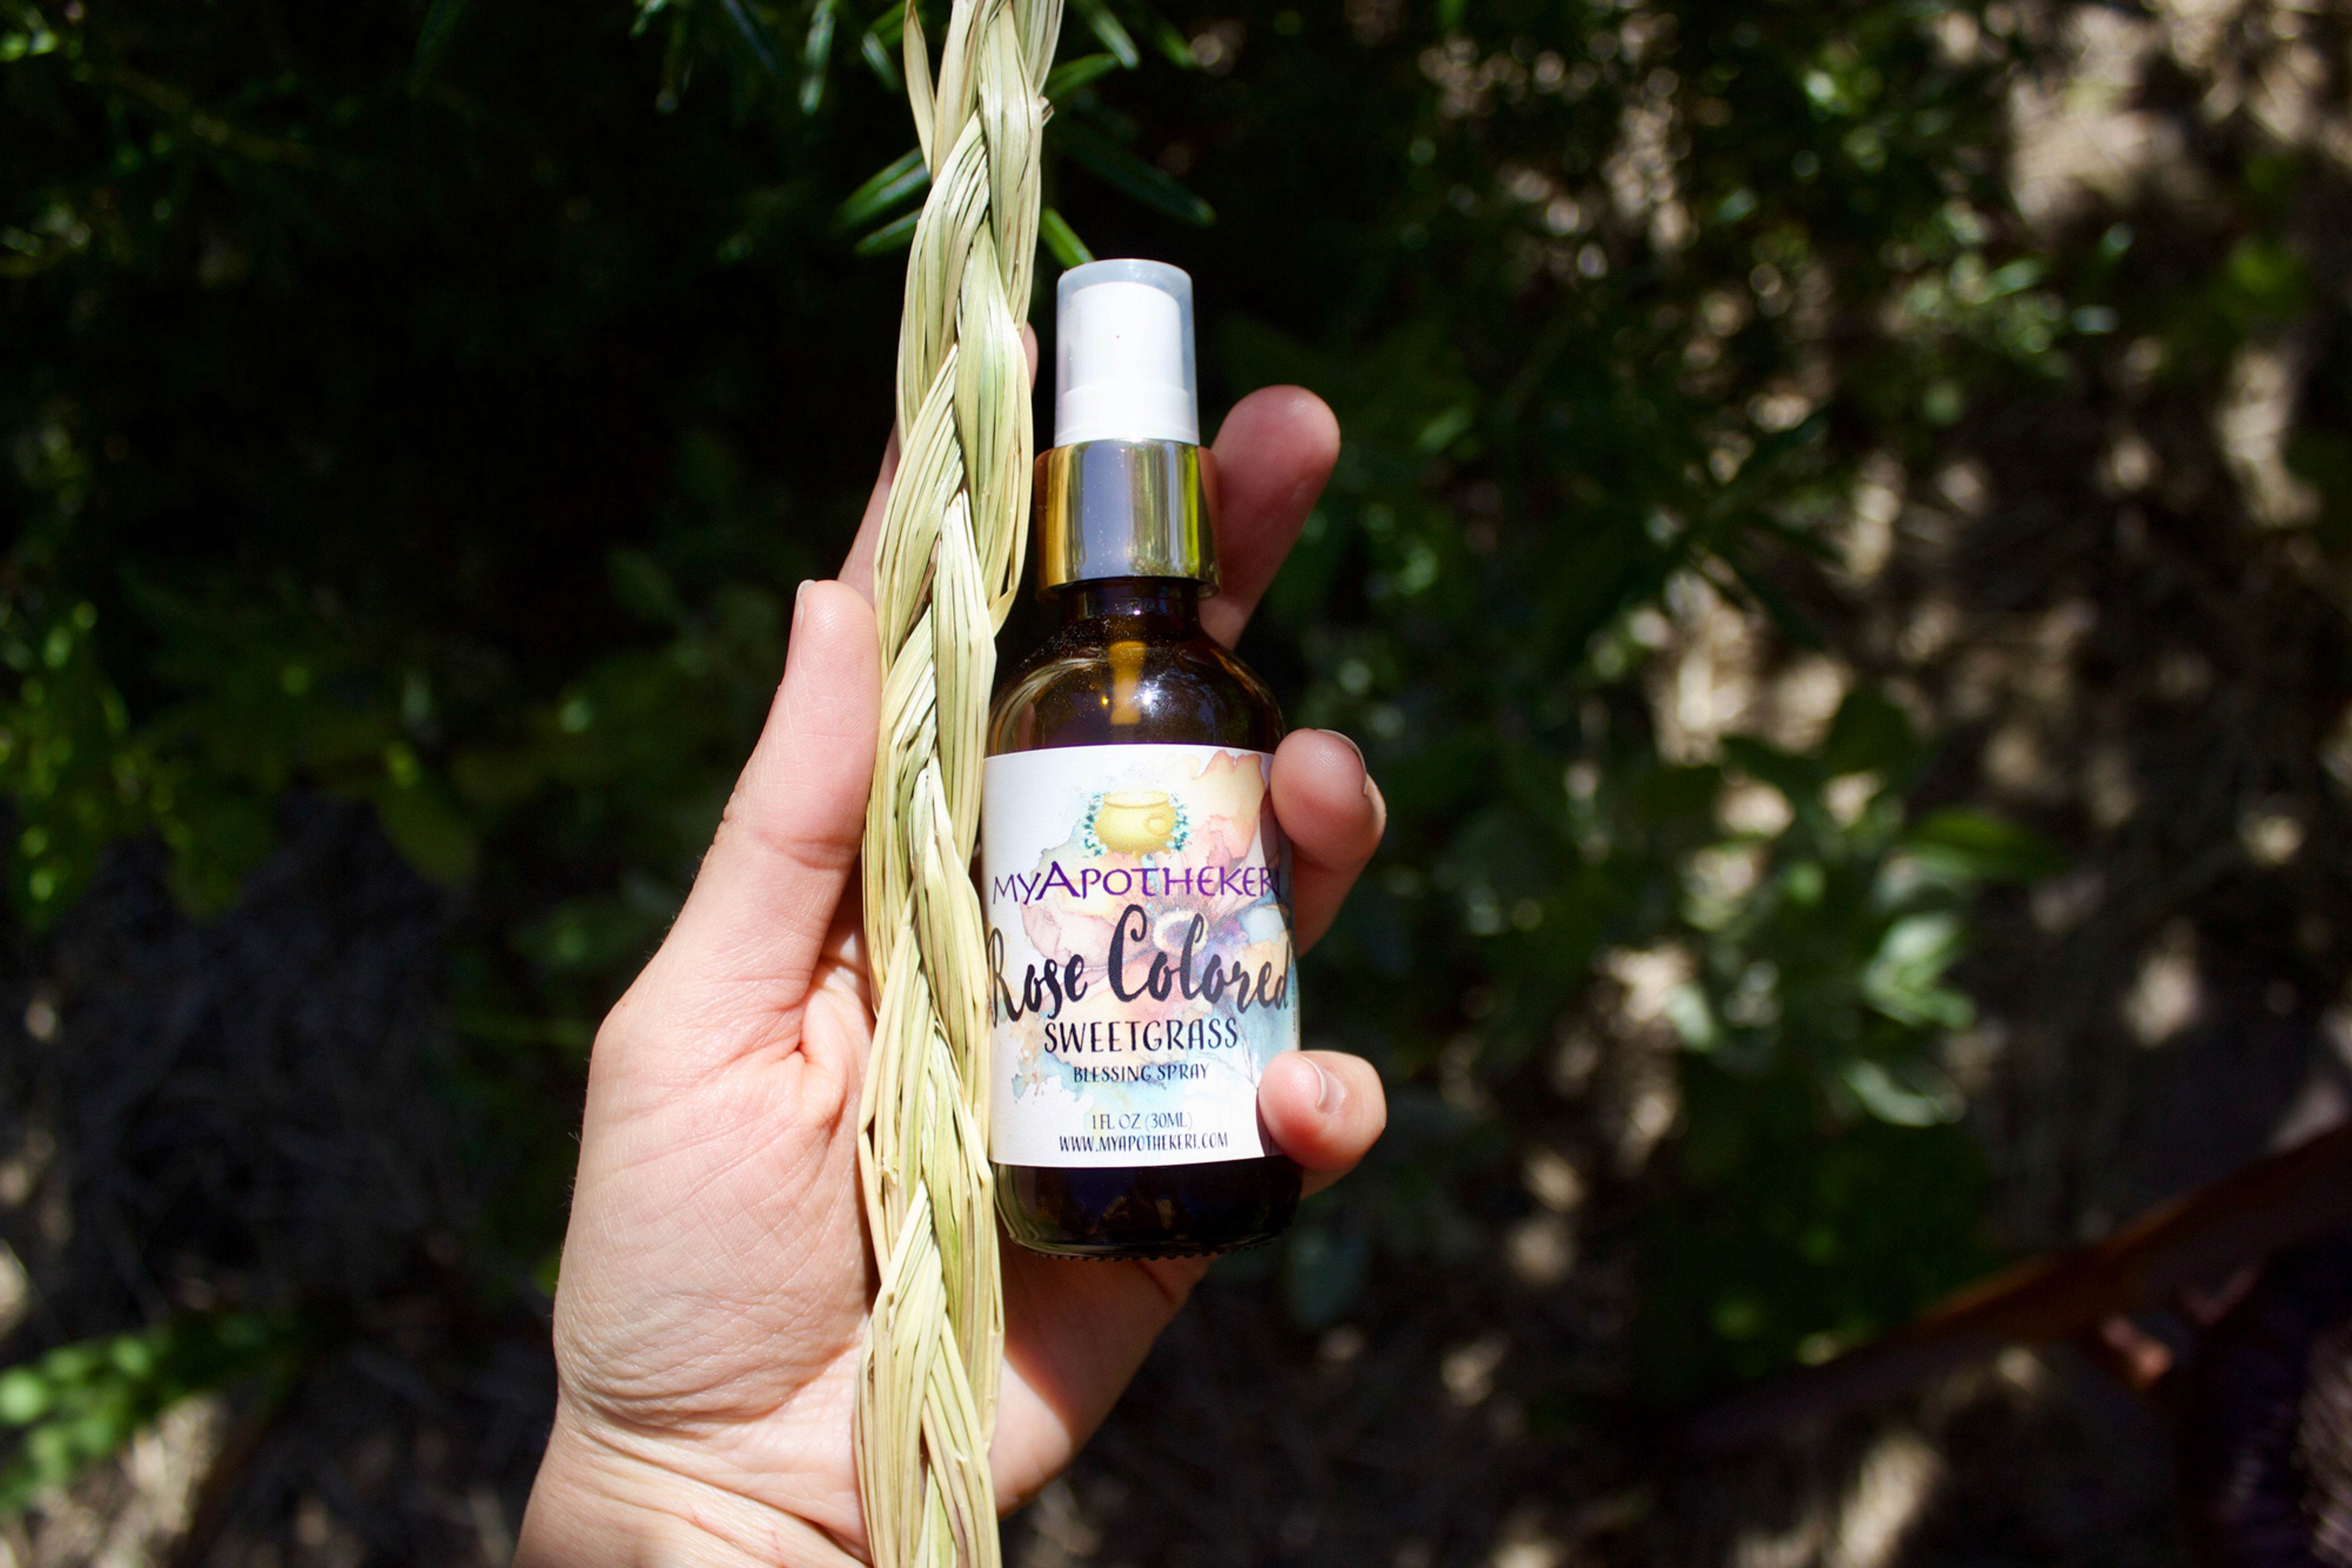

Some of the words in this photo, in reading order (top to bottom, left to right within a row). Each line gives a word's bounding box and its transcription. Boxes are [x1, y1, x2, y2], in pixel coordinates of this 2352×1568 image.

[987, 927, 1088, 1029] Rose
[1108, 904, 1289, 1012] Colored
[1044, 1018, 1238, 1054] SWEETGRASS
[1074, 1065, 1151, 1083] BLESSING
[1156, 1063, 1210, 1082] SPRAY
[1092, 1114, 1097, 1130] 1
[1100, 1114, 1115, 1130] FL
[1118, 1113, 1142, 1130] OZ
[1145, 1111, 1193, 1132] (30ML)
[1059, 1132, 1229, 1152] WWW.MYAPOTHEKERI.COM
